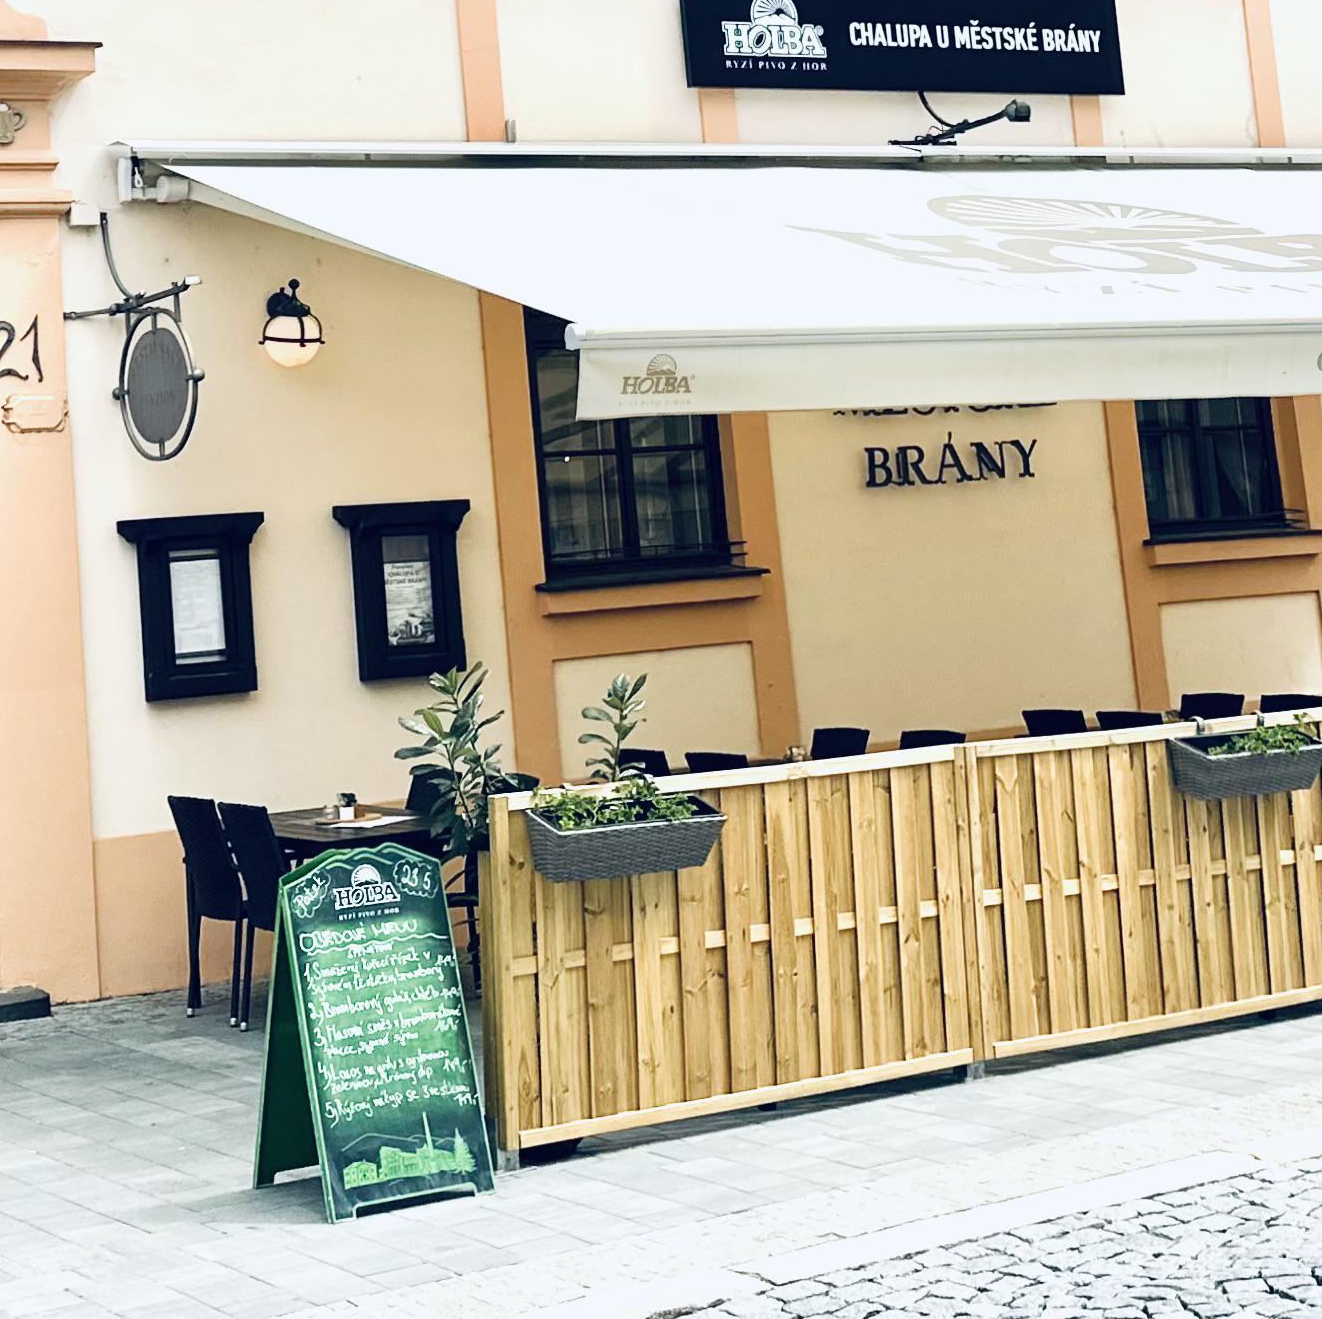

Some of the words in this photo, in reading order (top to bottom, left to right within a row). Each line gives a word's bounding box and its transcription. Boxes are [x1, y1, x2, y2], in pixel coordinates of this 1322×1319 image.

[721, 21, 827, 59] HOLBA
[848, 21, 933, 48] CHALUPA
[936, 25, 950, 49] U
[954, 19, 1039, 51] MĚSTSKÉ
[1042, 23, 1101, 53] BRÁNY
[758, 61, 786, 71] PIVO
[802, 62, 828, 71] HOR
[620, 375, 692, 395] HOLBA
[864, 431, 1038, 488] BRÁNY
[333, 882, 401, 911] HOLBA
